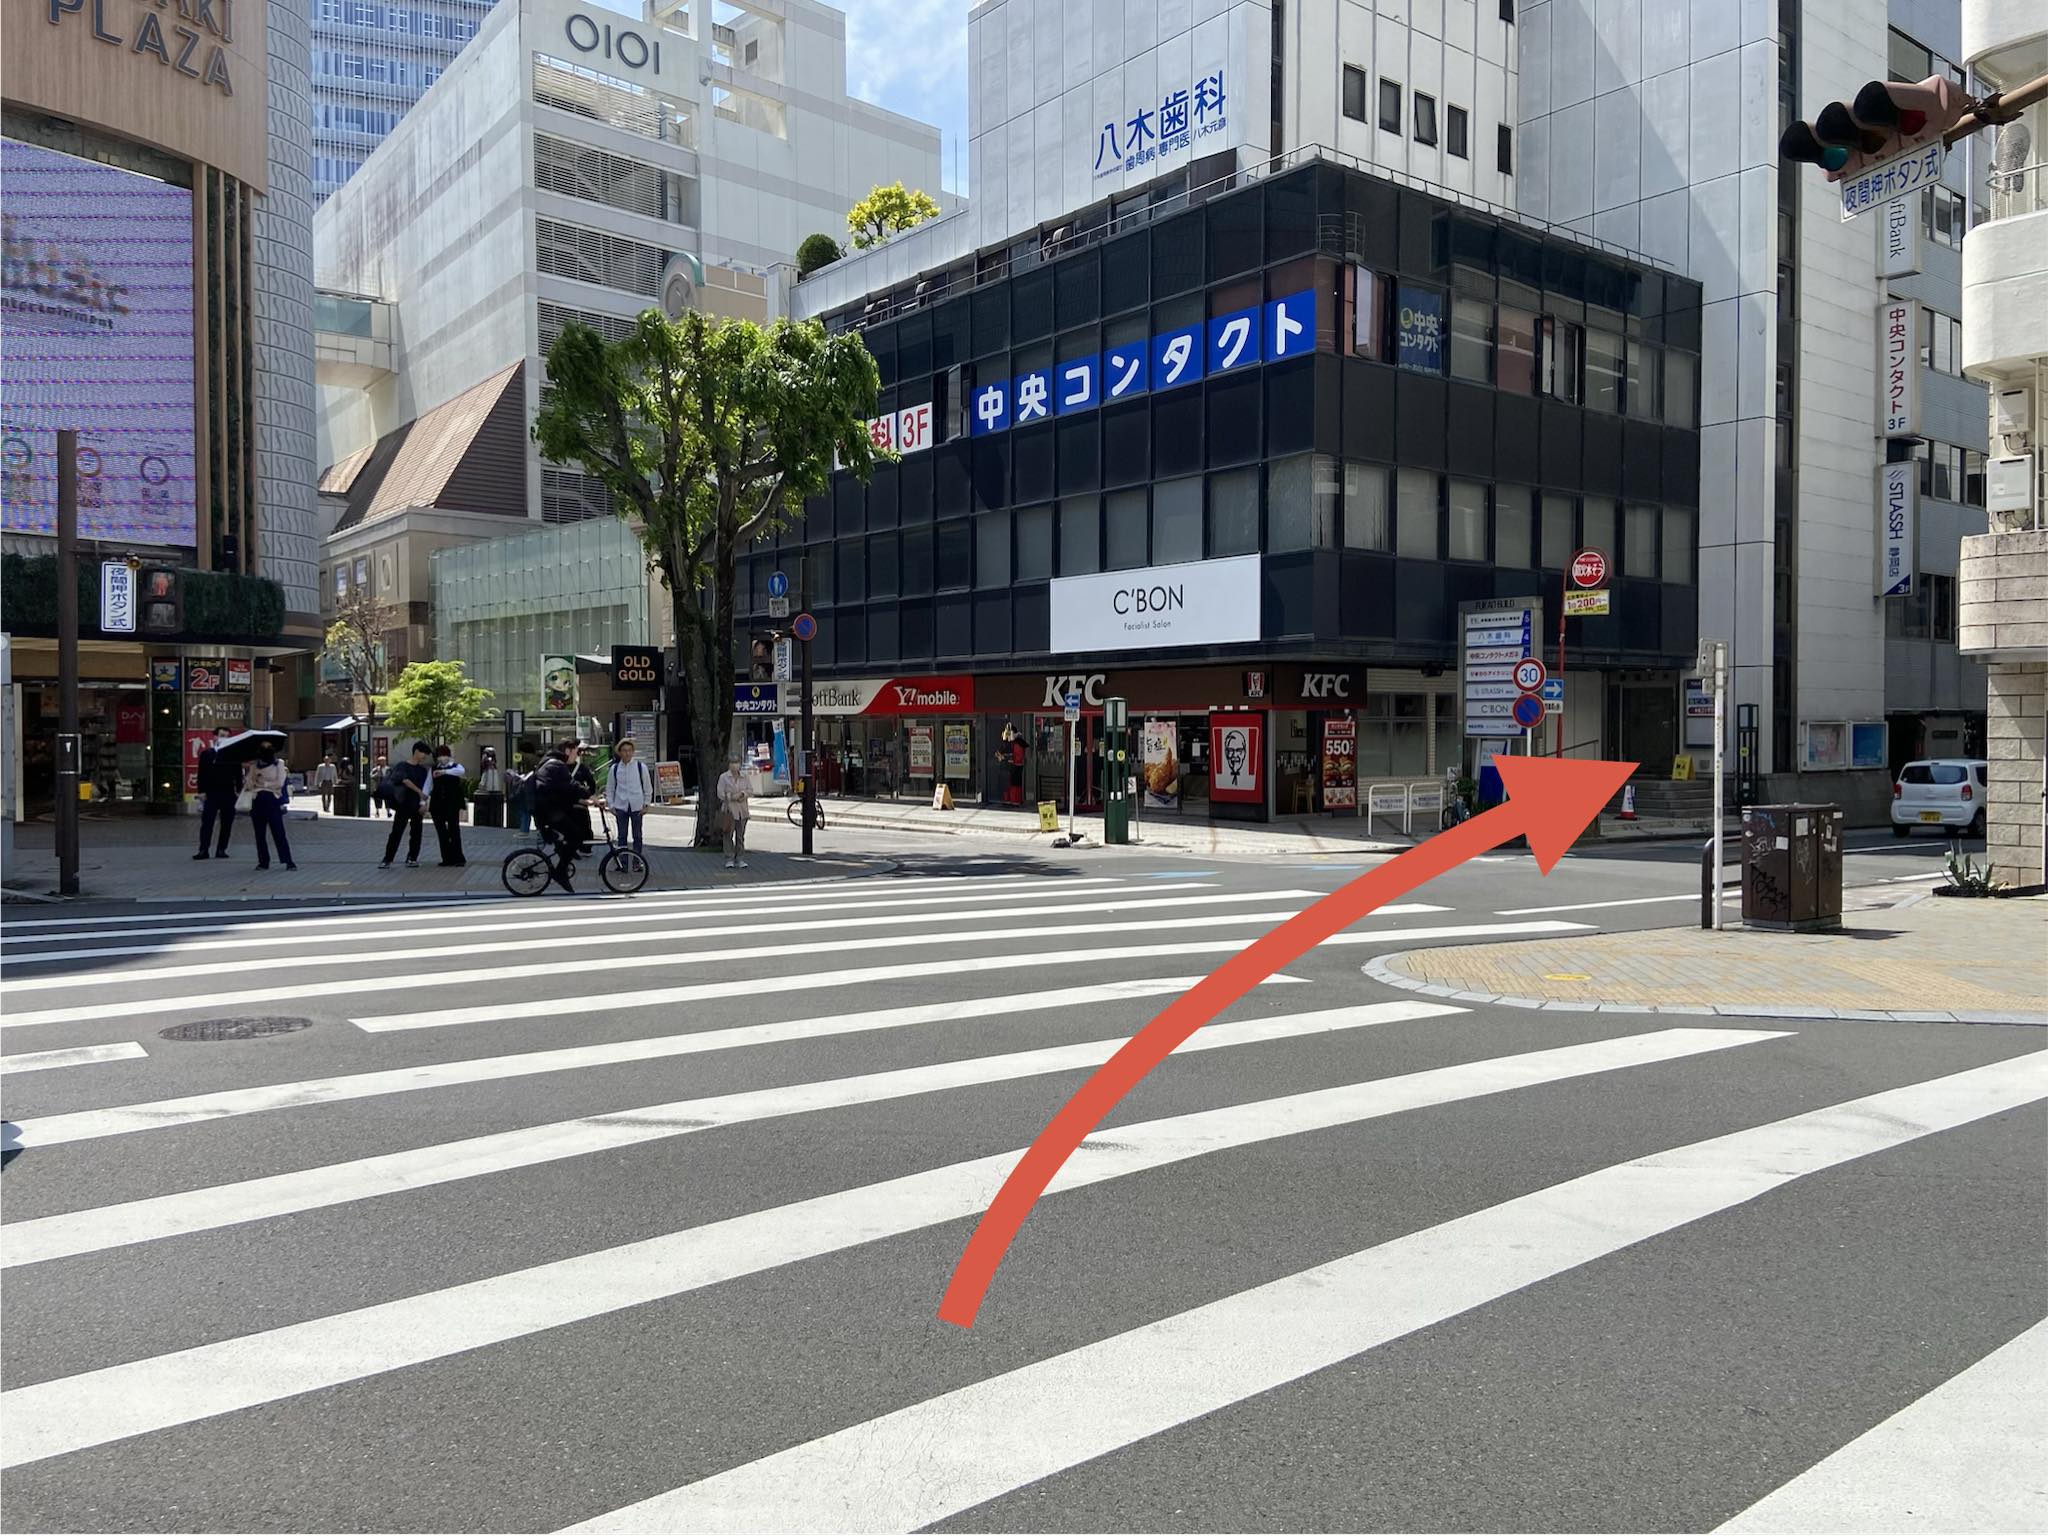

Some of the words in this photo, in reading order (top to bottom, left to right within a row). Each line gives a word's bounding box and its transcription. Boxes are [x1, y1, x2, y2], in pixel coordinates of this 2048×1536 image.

[49, 0, 233, 97] PLAZA
[1095, 70, 1226, 170] 八木歯科
[1845, 148, 1938, 212] 夜間押ボタン式
[1414, 310, 1439, 336] 中央
[1400, 331, 1439, 353] コンタクト
[978, 302, 1303, 430] 中央コンタクト
[1889, 308, 1906, 414] 中央コンタクト
[903, 408, 928, 448] 3F
[1889, 482, 1904, 540] STLASSH
[110, 567, 128, 628] 夜間押ボタン式
[1113, 584, 1183, 615] C'BON
[1124, 621, 1150, 631] Facialist
[1152, 619, 1171, 629] Salon
[618, 669, 656, 681] GOLD
[623, 656, 650, 668] OLD
[190, 667, 220, 690] 2F
[1301, 673, 1350, 698] KFC
[1520, 668, 1538, 683] 30
[1042, 674, 1105, 707] KFC
[735, 699, 778, 712] 中央コンタクト
[1481, 704, 1509, 713] C'BON
[1325, 740, 1350, 755] 550
